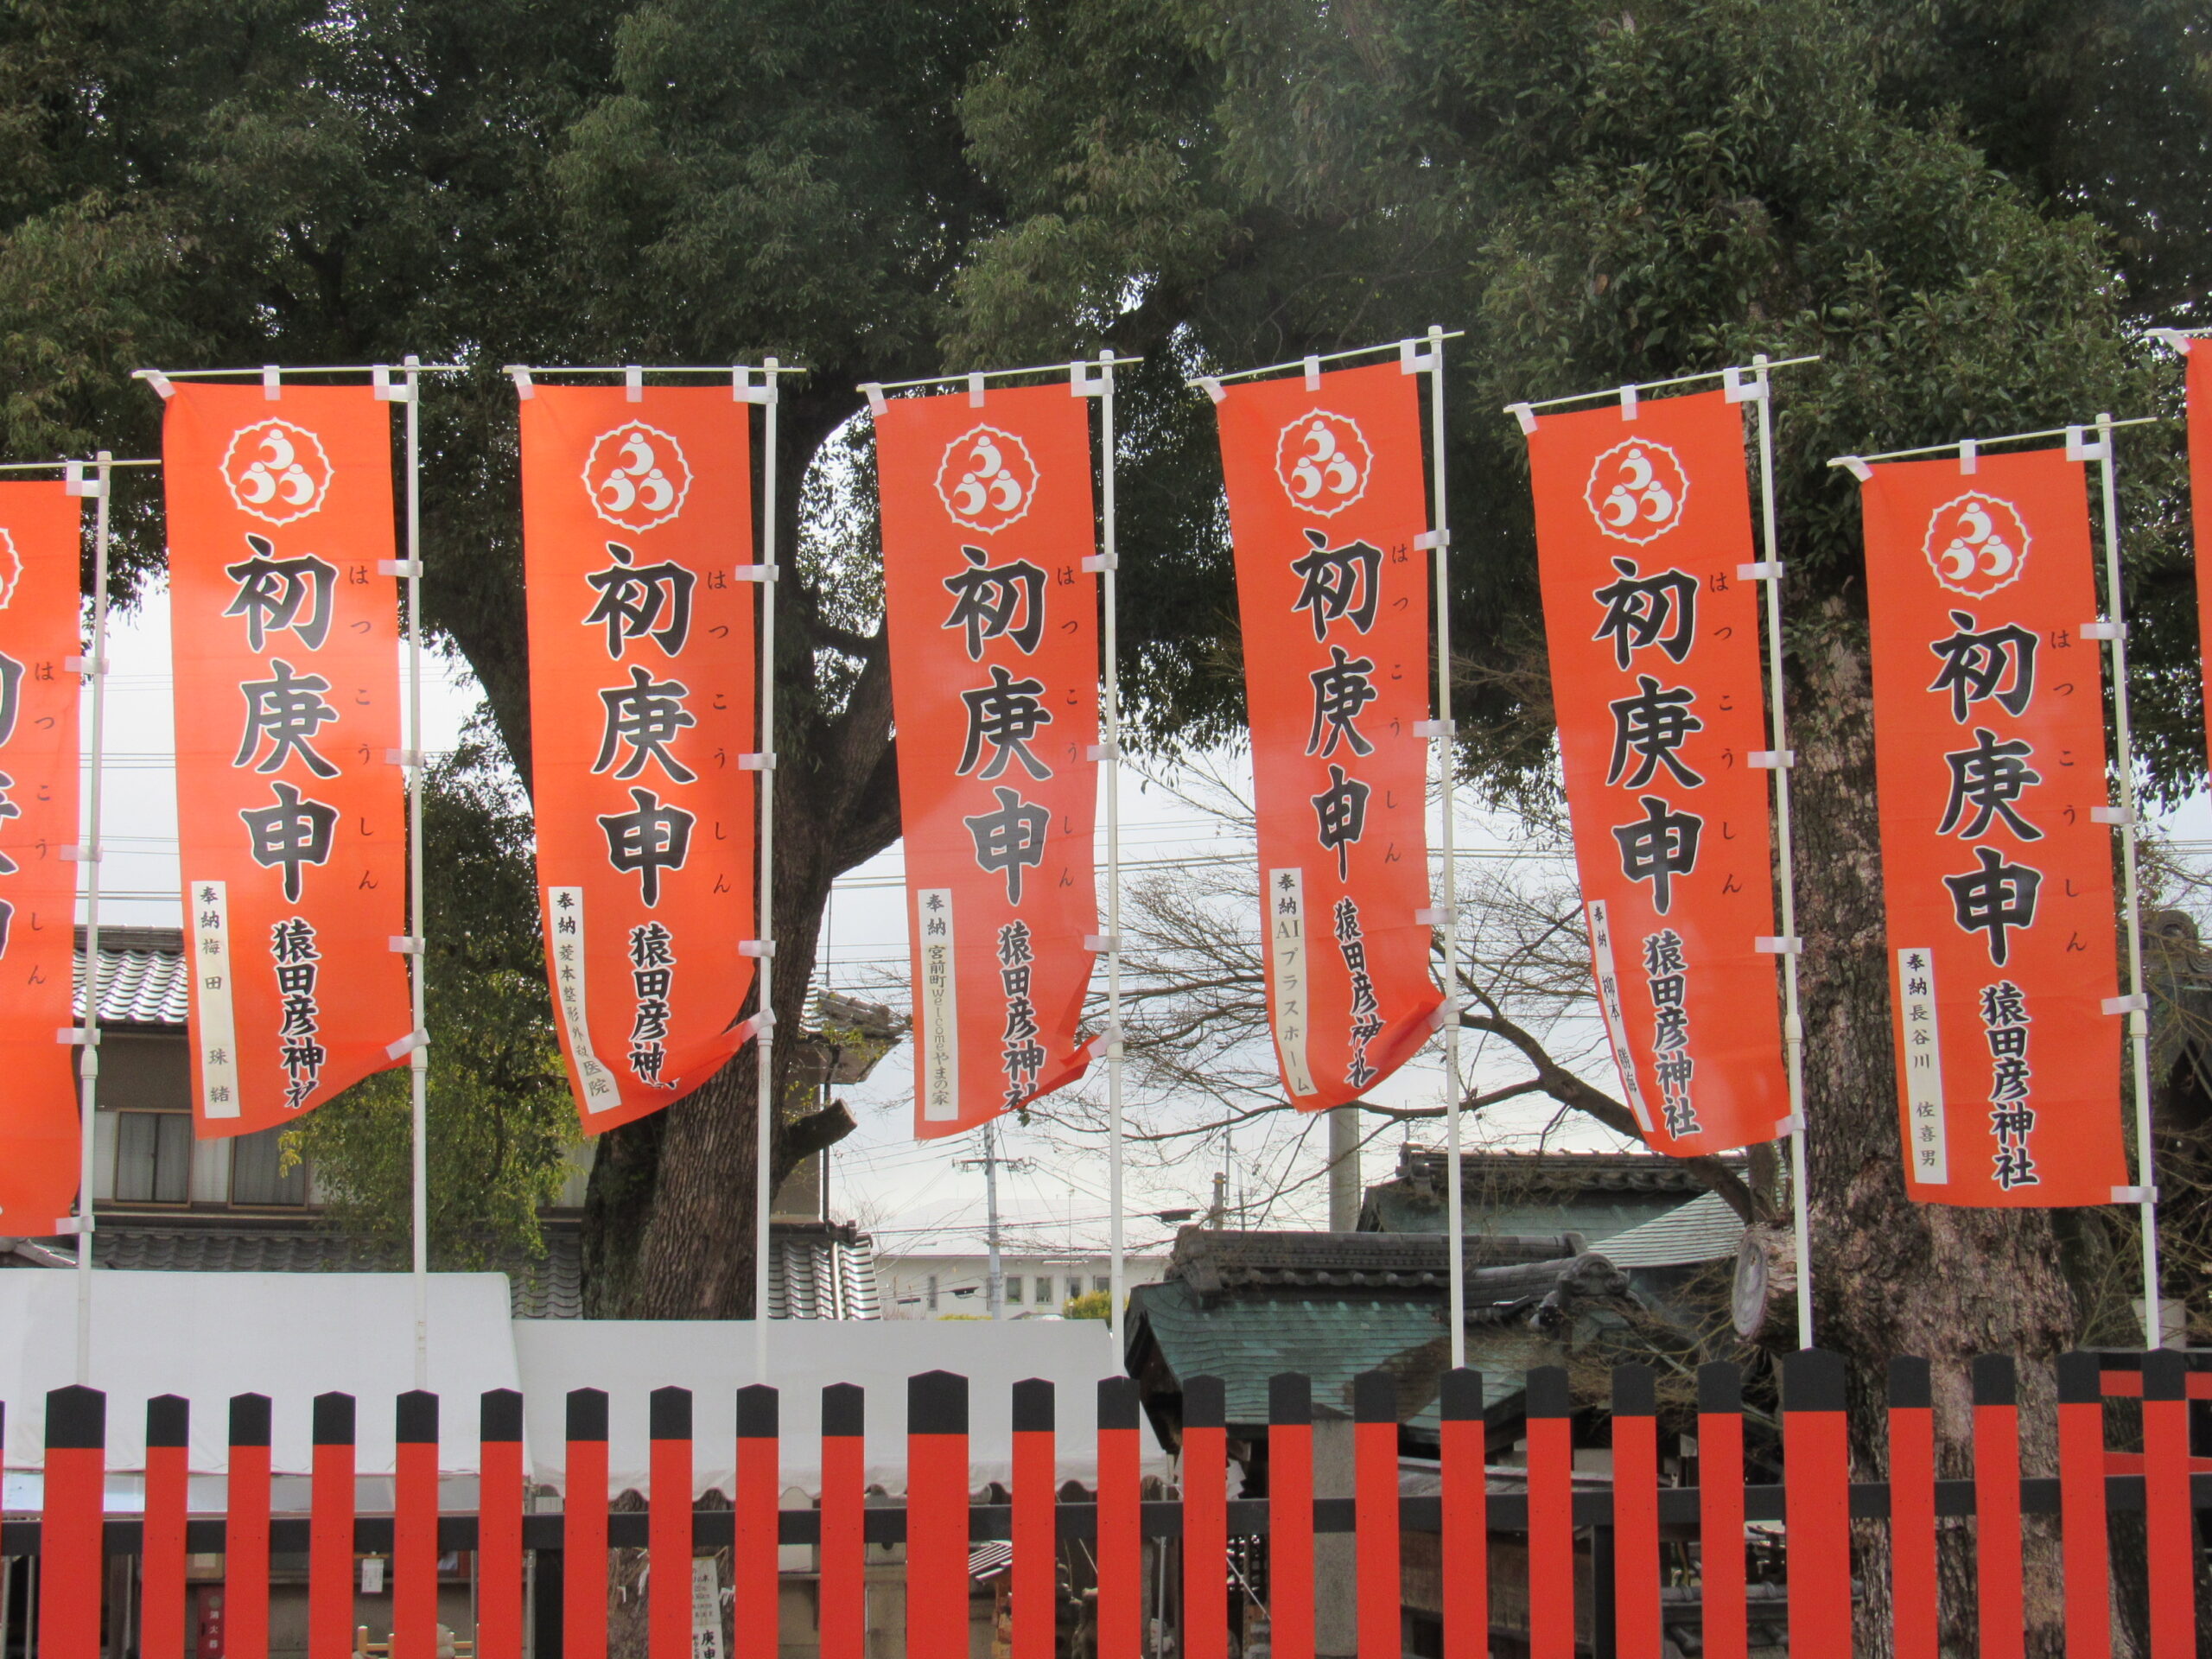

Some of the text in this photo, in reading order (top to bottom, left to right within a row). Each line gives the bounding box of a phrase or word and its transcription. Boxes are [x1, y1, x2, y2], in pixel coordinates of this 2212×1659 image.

[221, 534, 340, 905] 初庚申
[582, 543, 696, 908] 初庚申
[940, 544, 1052, 906] 初庚申
[1291, 527, 1382, 883] 初庚申
[1592, 556, 1705, 916] 初庚申
[1928, 609, 2043, 968] 初庚申
[627, 925, 681, 1090] 猿田彦神
[1643, 929, 1700, 1141] 猿田彦神社
[1980, 981, 2039, 1192] 猿田彦神社
